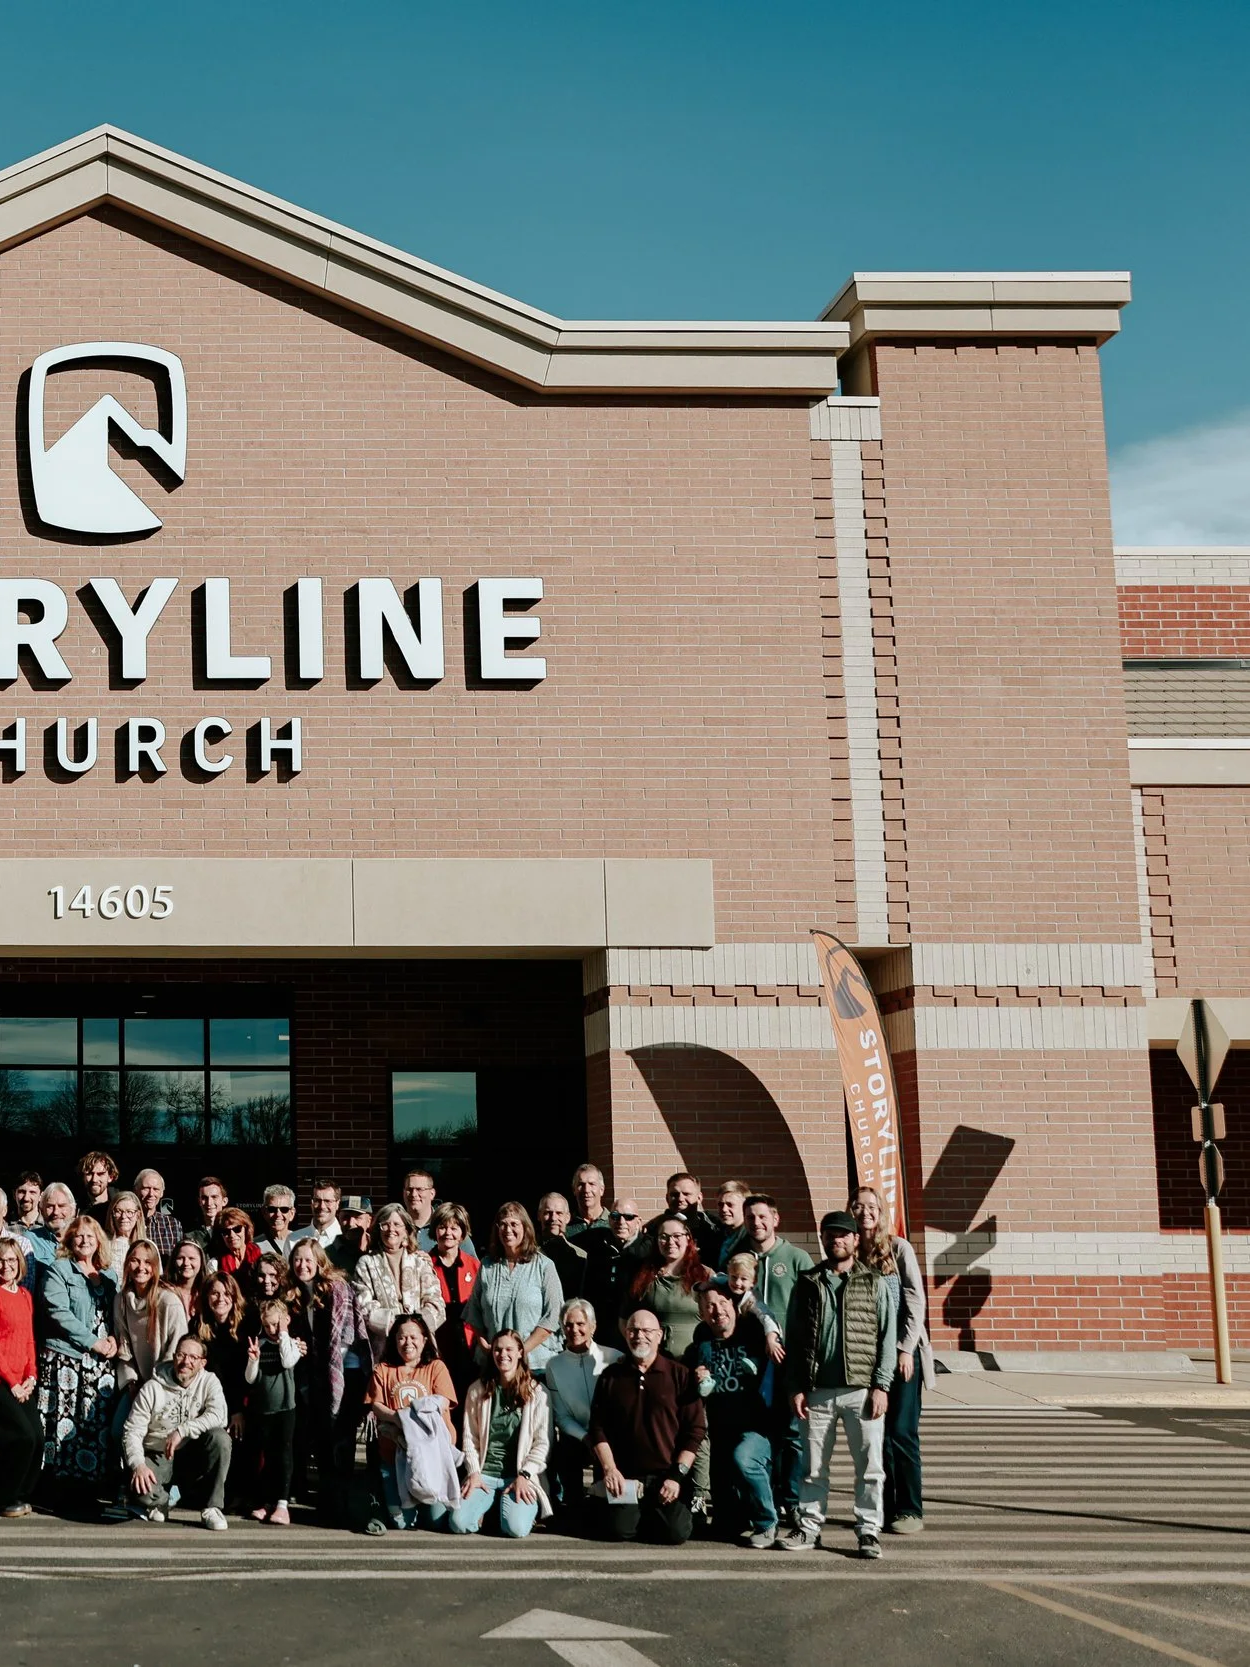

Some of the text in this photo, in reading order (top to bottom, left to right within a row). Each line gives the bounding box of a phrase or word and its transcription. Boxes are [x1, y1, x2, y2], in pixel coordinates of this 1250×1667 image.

[48, 884, 174, 919] 14605
[850, 1083, 874, 1182] CHURCH
[709, 1346, 747, 1362] ESUS
[714, 1376, 744, 1393] RO.
